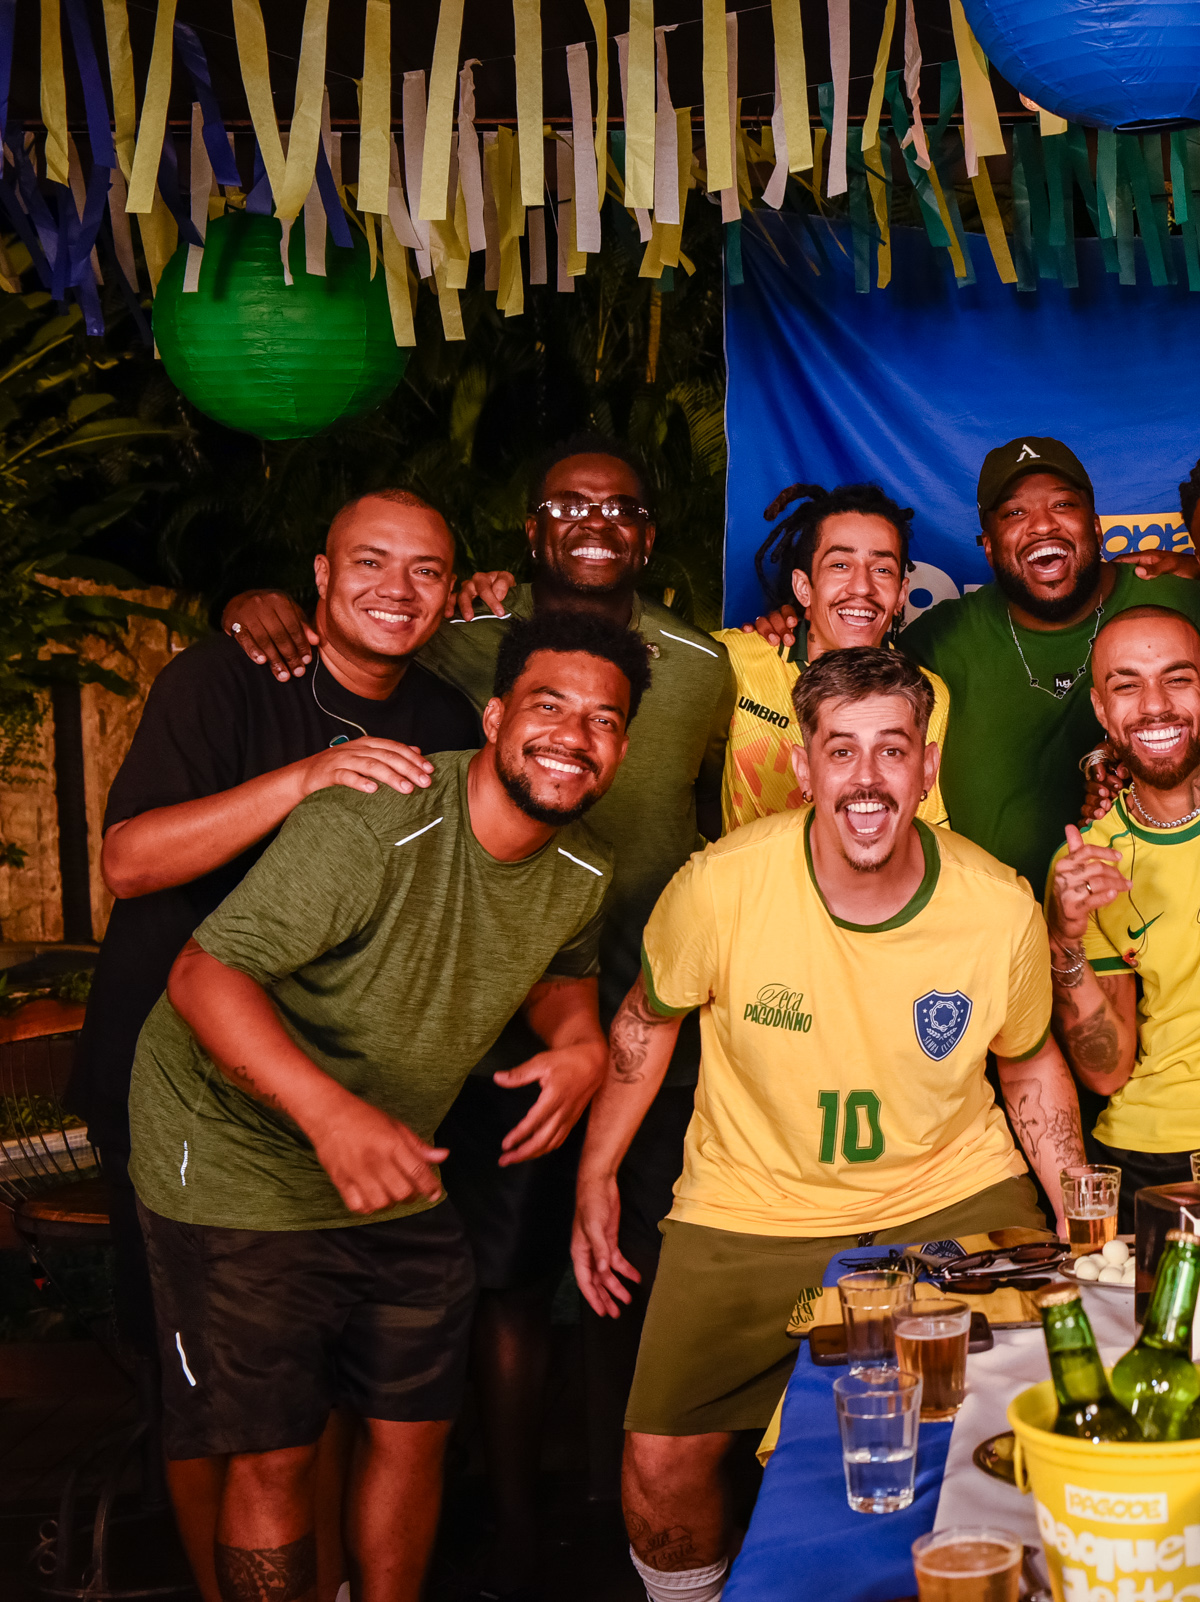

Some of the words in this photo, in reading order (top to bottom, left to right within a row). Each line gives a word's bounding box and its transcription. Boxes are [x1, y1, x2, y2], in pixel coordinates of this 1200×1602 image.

[738, 696, 790, 729] UMBRO
[755, 983, 804, 1011] Zeca
[743, 1003, 813, 1033] PAGODINHO
[817, 1089, 886, 1165] 10
[1068, 1491, 1162, 1519] PAGODE
